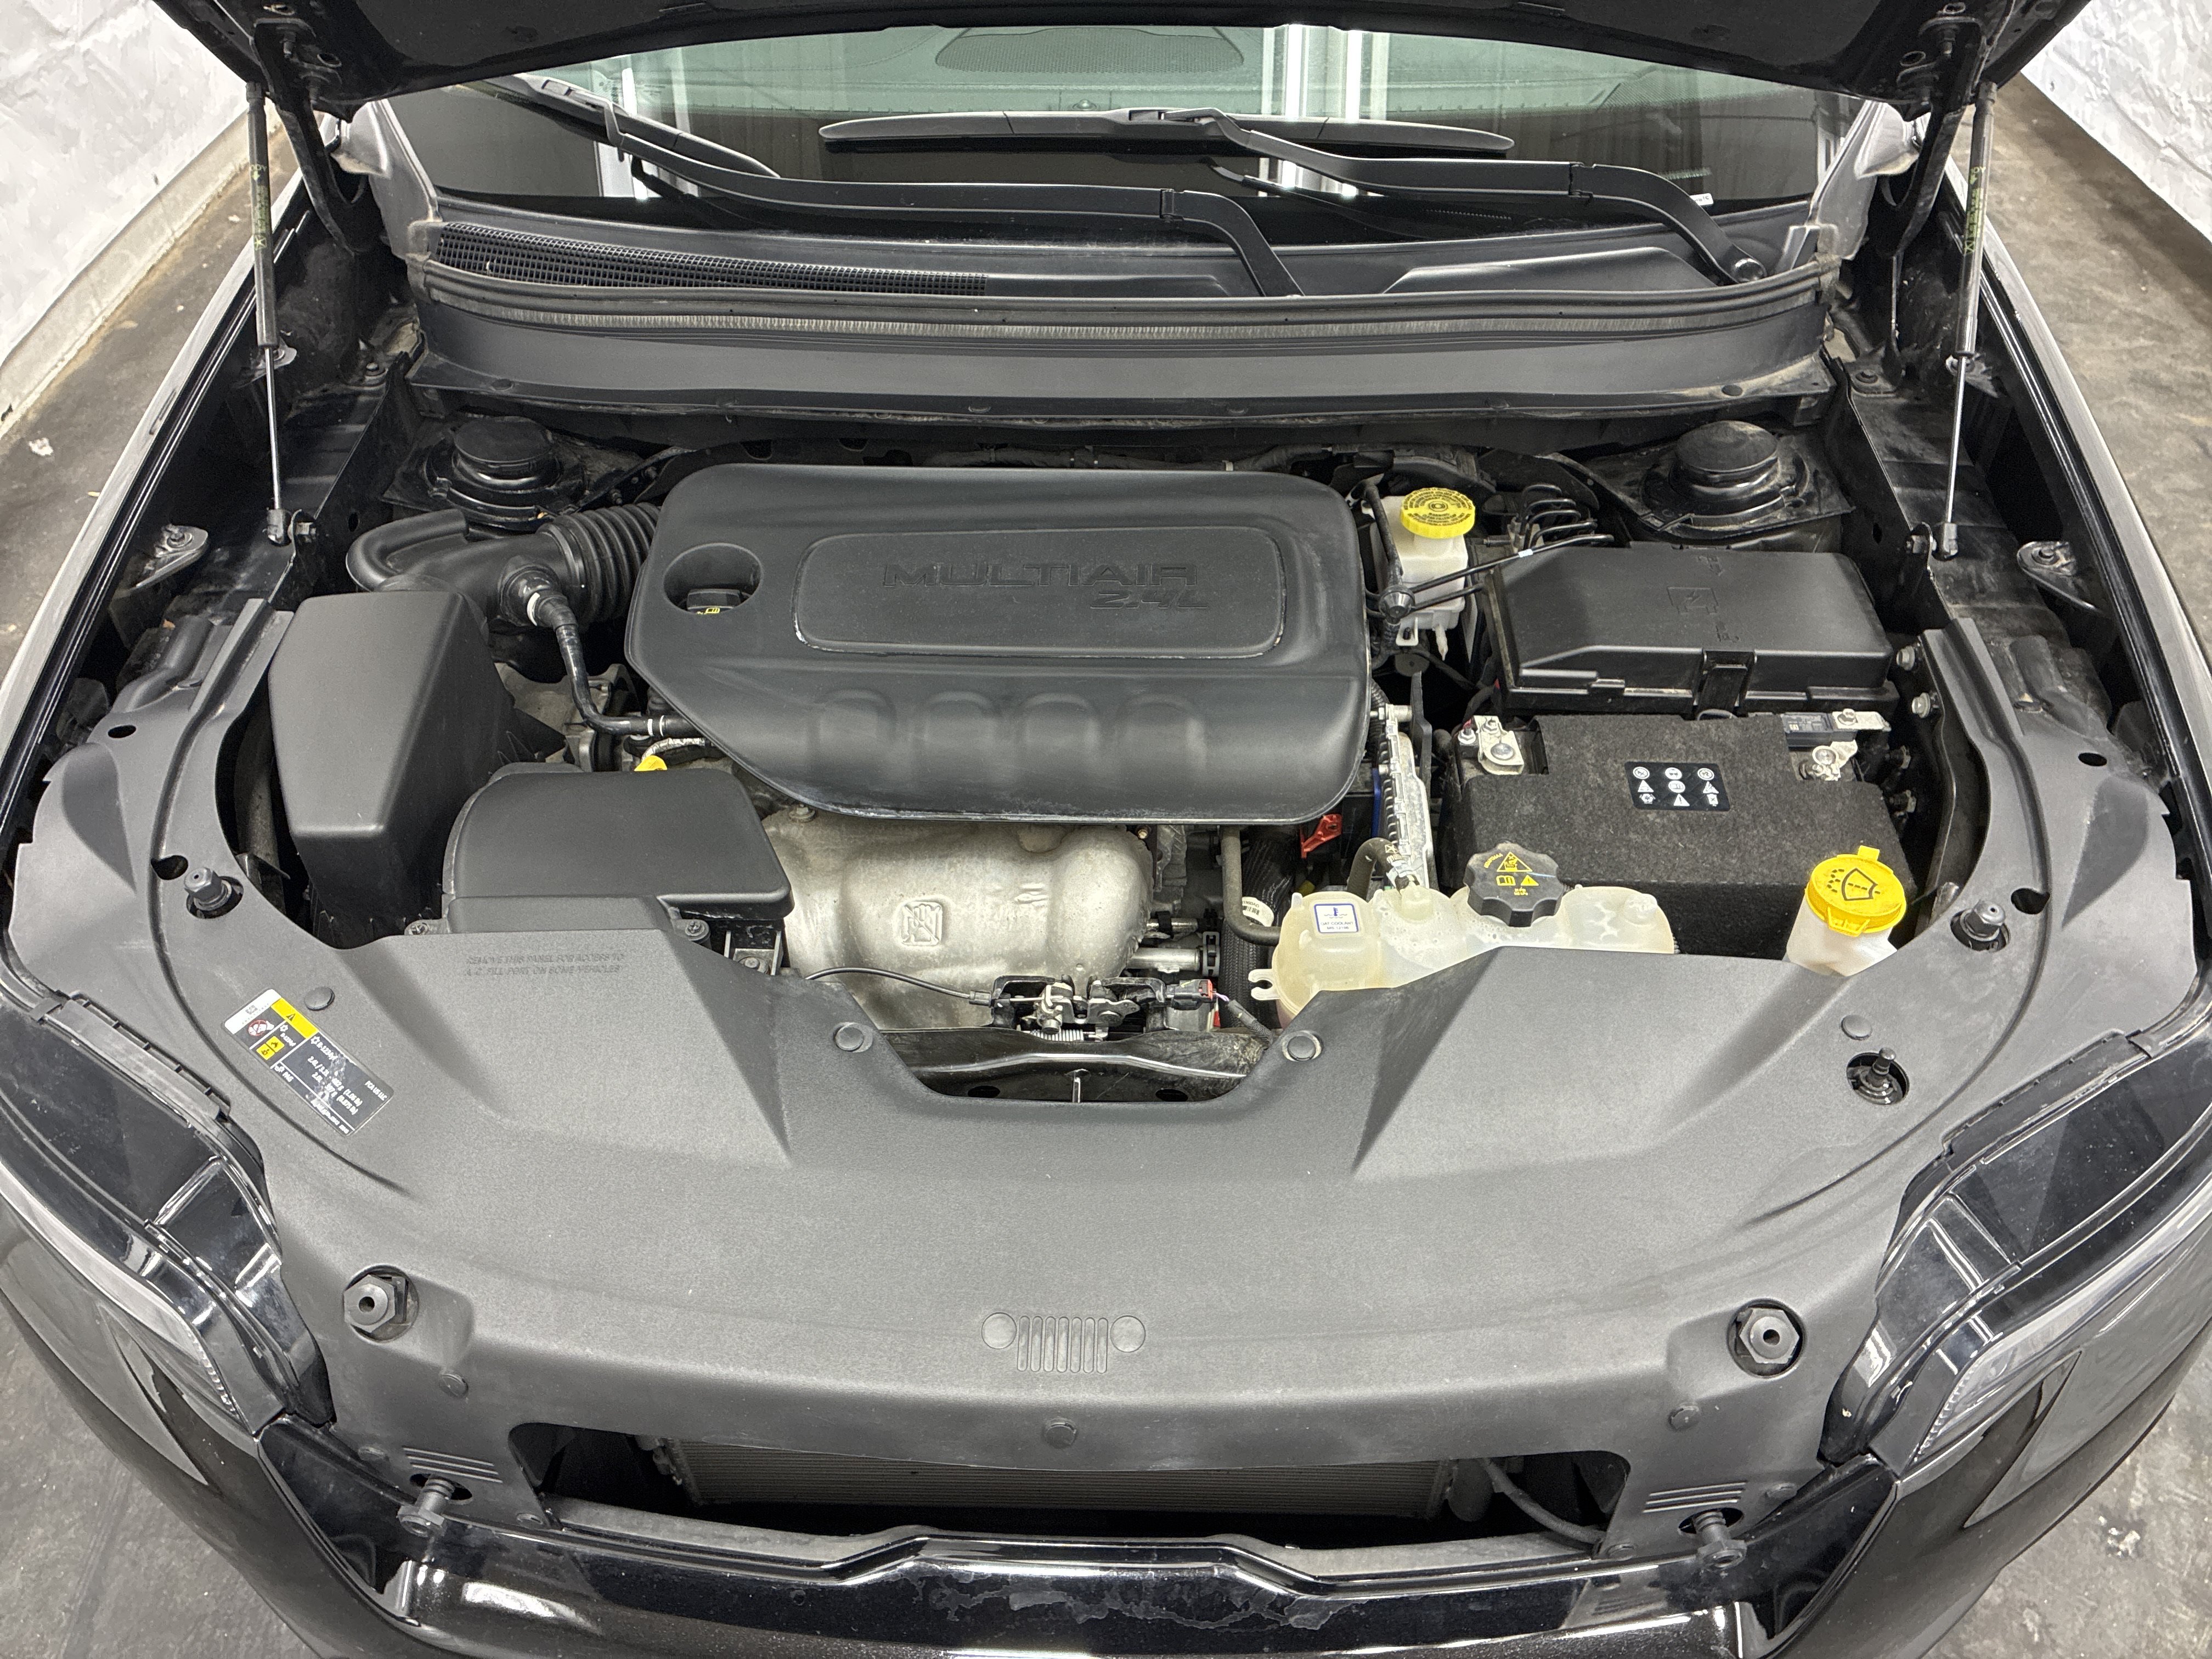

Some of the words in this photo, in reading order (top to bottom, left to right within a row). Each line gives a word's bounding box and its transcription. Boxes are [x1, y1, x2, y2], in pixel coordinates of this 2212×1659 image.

[882, 563, 1198, 586] MULTIAIR
[1090, 589, 1209, 609] 2.4L
[317, 1042, 339, 1063] R-1234yf
[283, 1071, 294, 1082] PAG
[365, 1081, 375, 1090] FCA
[378, 1092, 387, 1101] LLC
